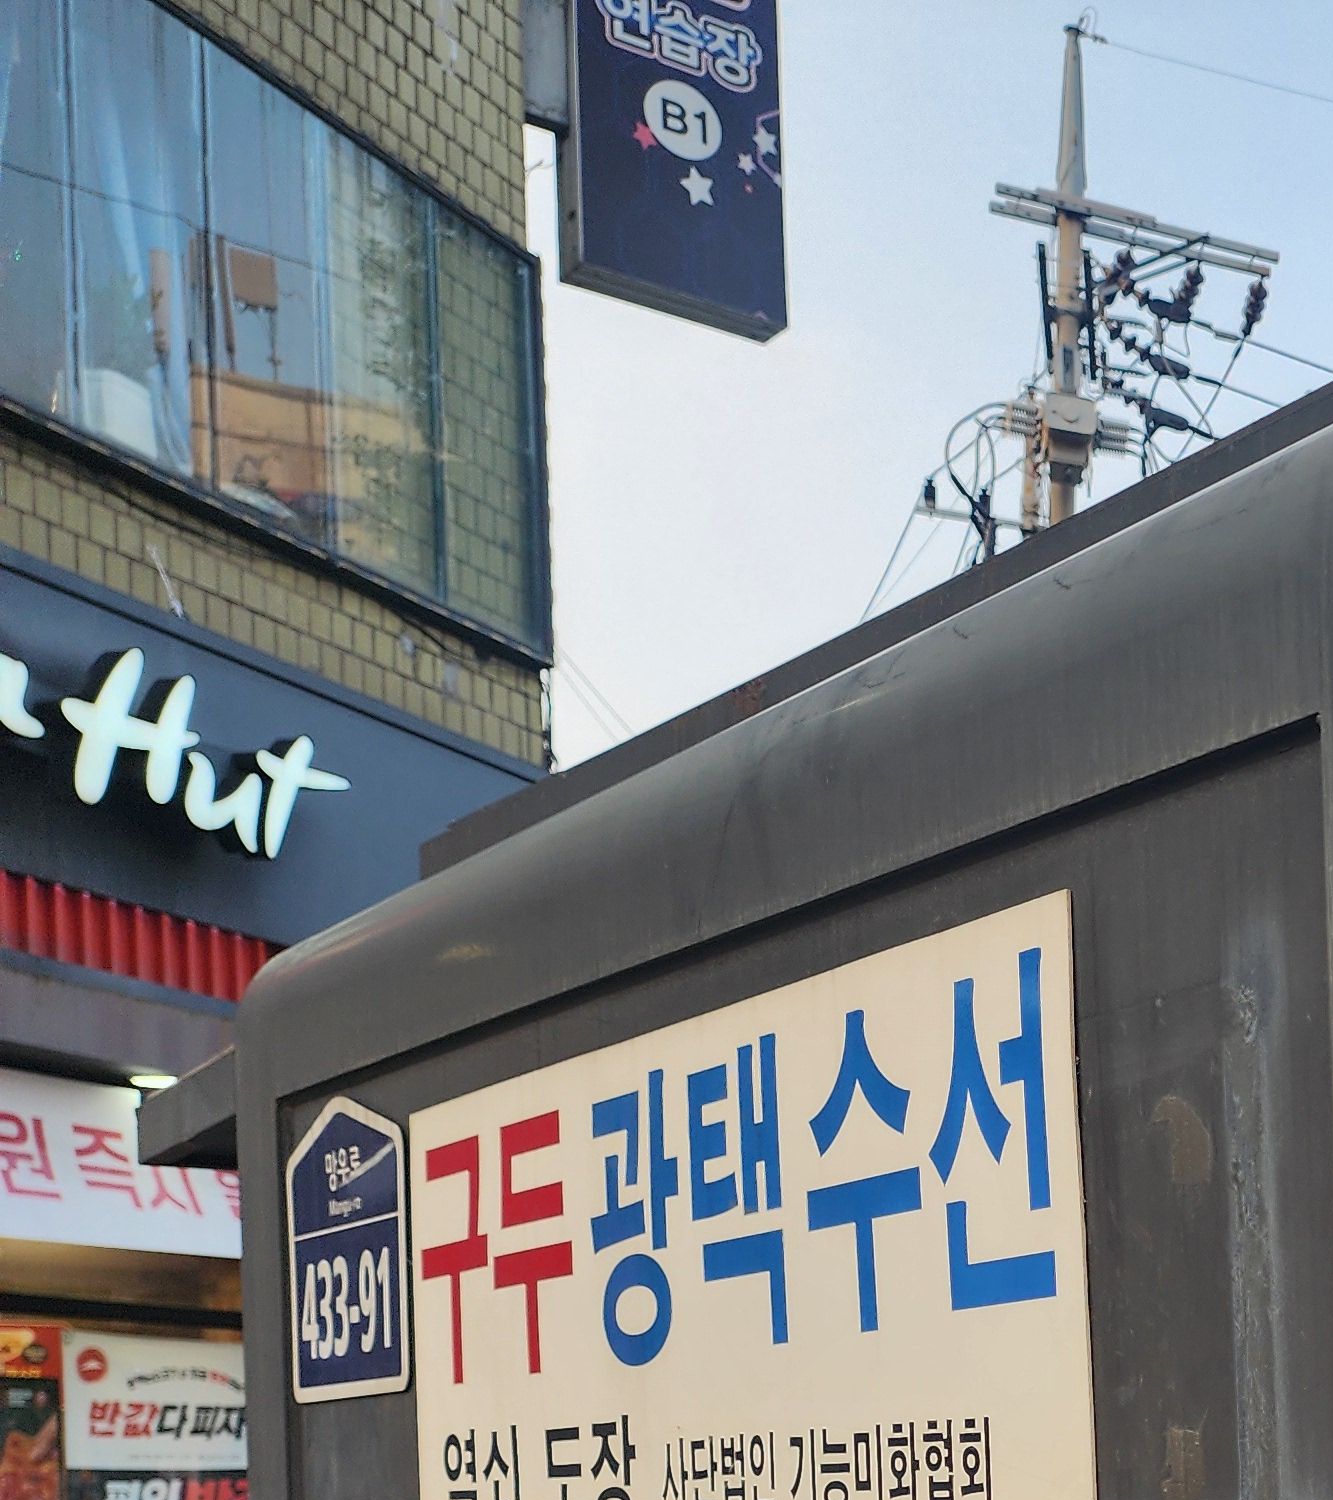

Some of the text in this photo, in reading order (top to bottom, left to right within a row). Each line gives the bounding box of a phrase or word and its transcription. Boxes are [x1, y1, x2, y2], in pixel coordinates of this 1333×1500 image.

[661, 97, 707, 146] B1
[60, 647, 351, 859] Hut
[72, 1123, 241, 1218] 즉시
[420, 946, 1057, 1385] 구두 광택수선
[302, 1246, 393, 1361] 433-91
